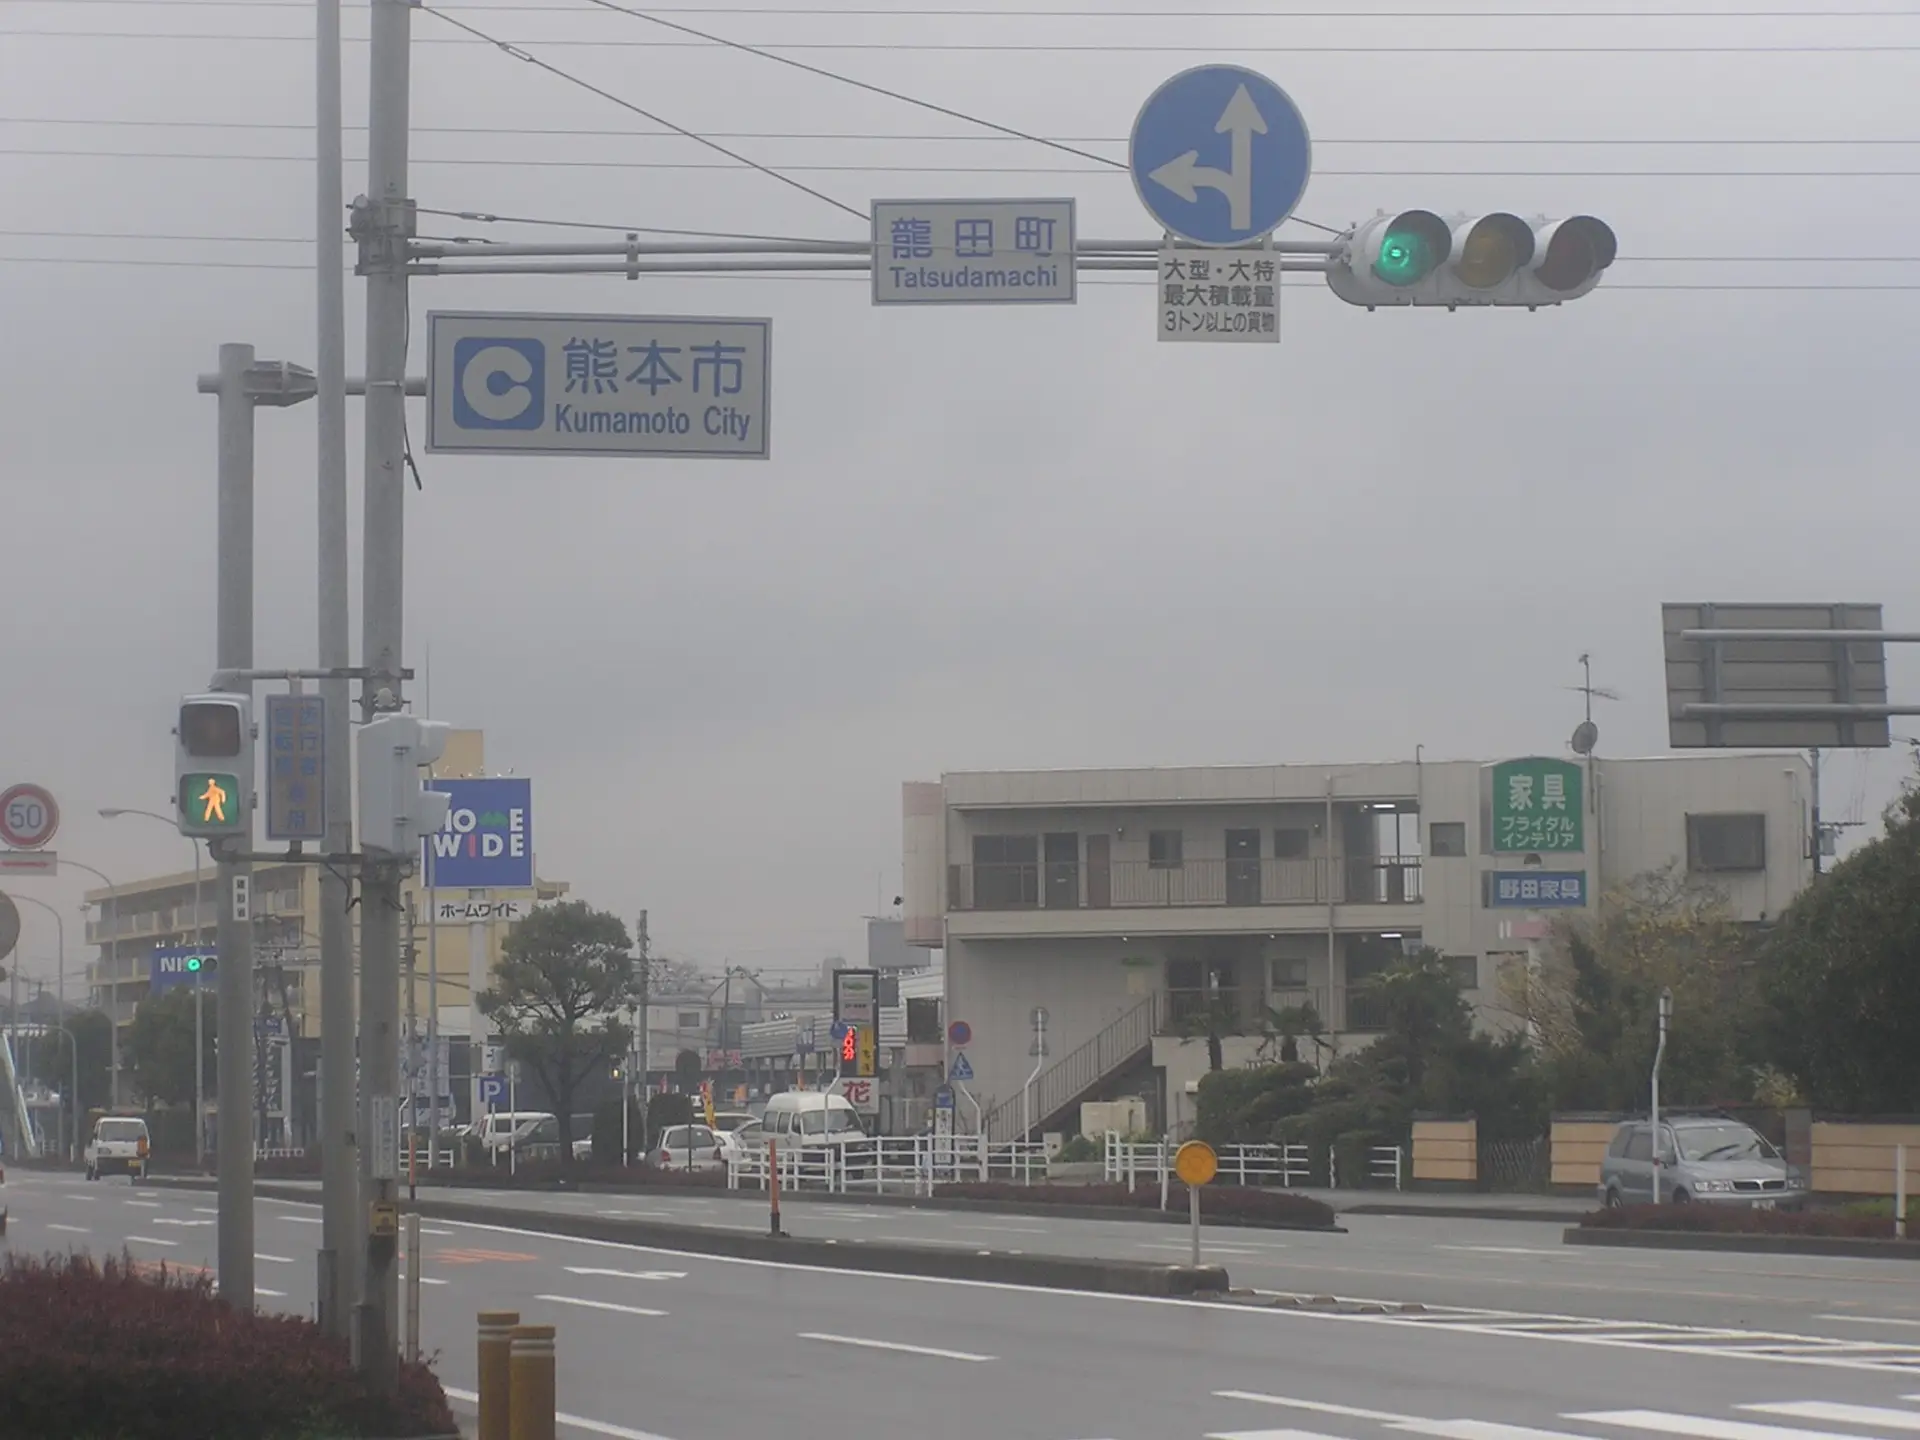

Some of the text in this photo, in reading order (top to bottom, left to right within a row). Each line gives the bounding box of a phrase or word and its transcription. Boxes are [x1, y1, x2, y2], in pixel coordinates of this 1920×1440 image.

[891, 216, 1057, 259] 龍田町
[889, 265, 1057, 289] Tatsudamachi
[1164, 258, 1275, 281] 大型・大特
[1164, 284, 1275, 307] 最大積載量
[562, 337, 747, 397] 熊本市
[555, 403, 750, 441] Kumamoto City
[1509, 774, 1566, 811] 家具
[9, 804, 42, 829] 50
[433, 833, 524, 857] WIDE
[1502, 832, 1574, 848] インテリア
[1500, 879, 1580, 898] 野田家具
[440, 903, 518, 918] ホームワイド
[483, 1080, 501, 1111] P
[842, 1080, 871, 1103] 花
